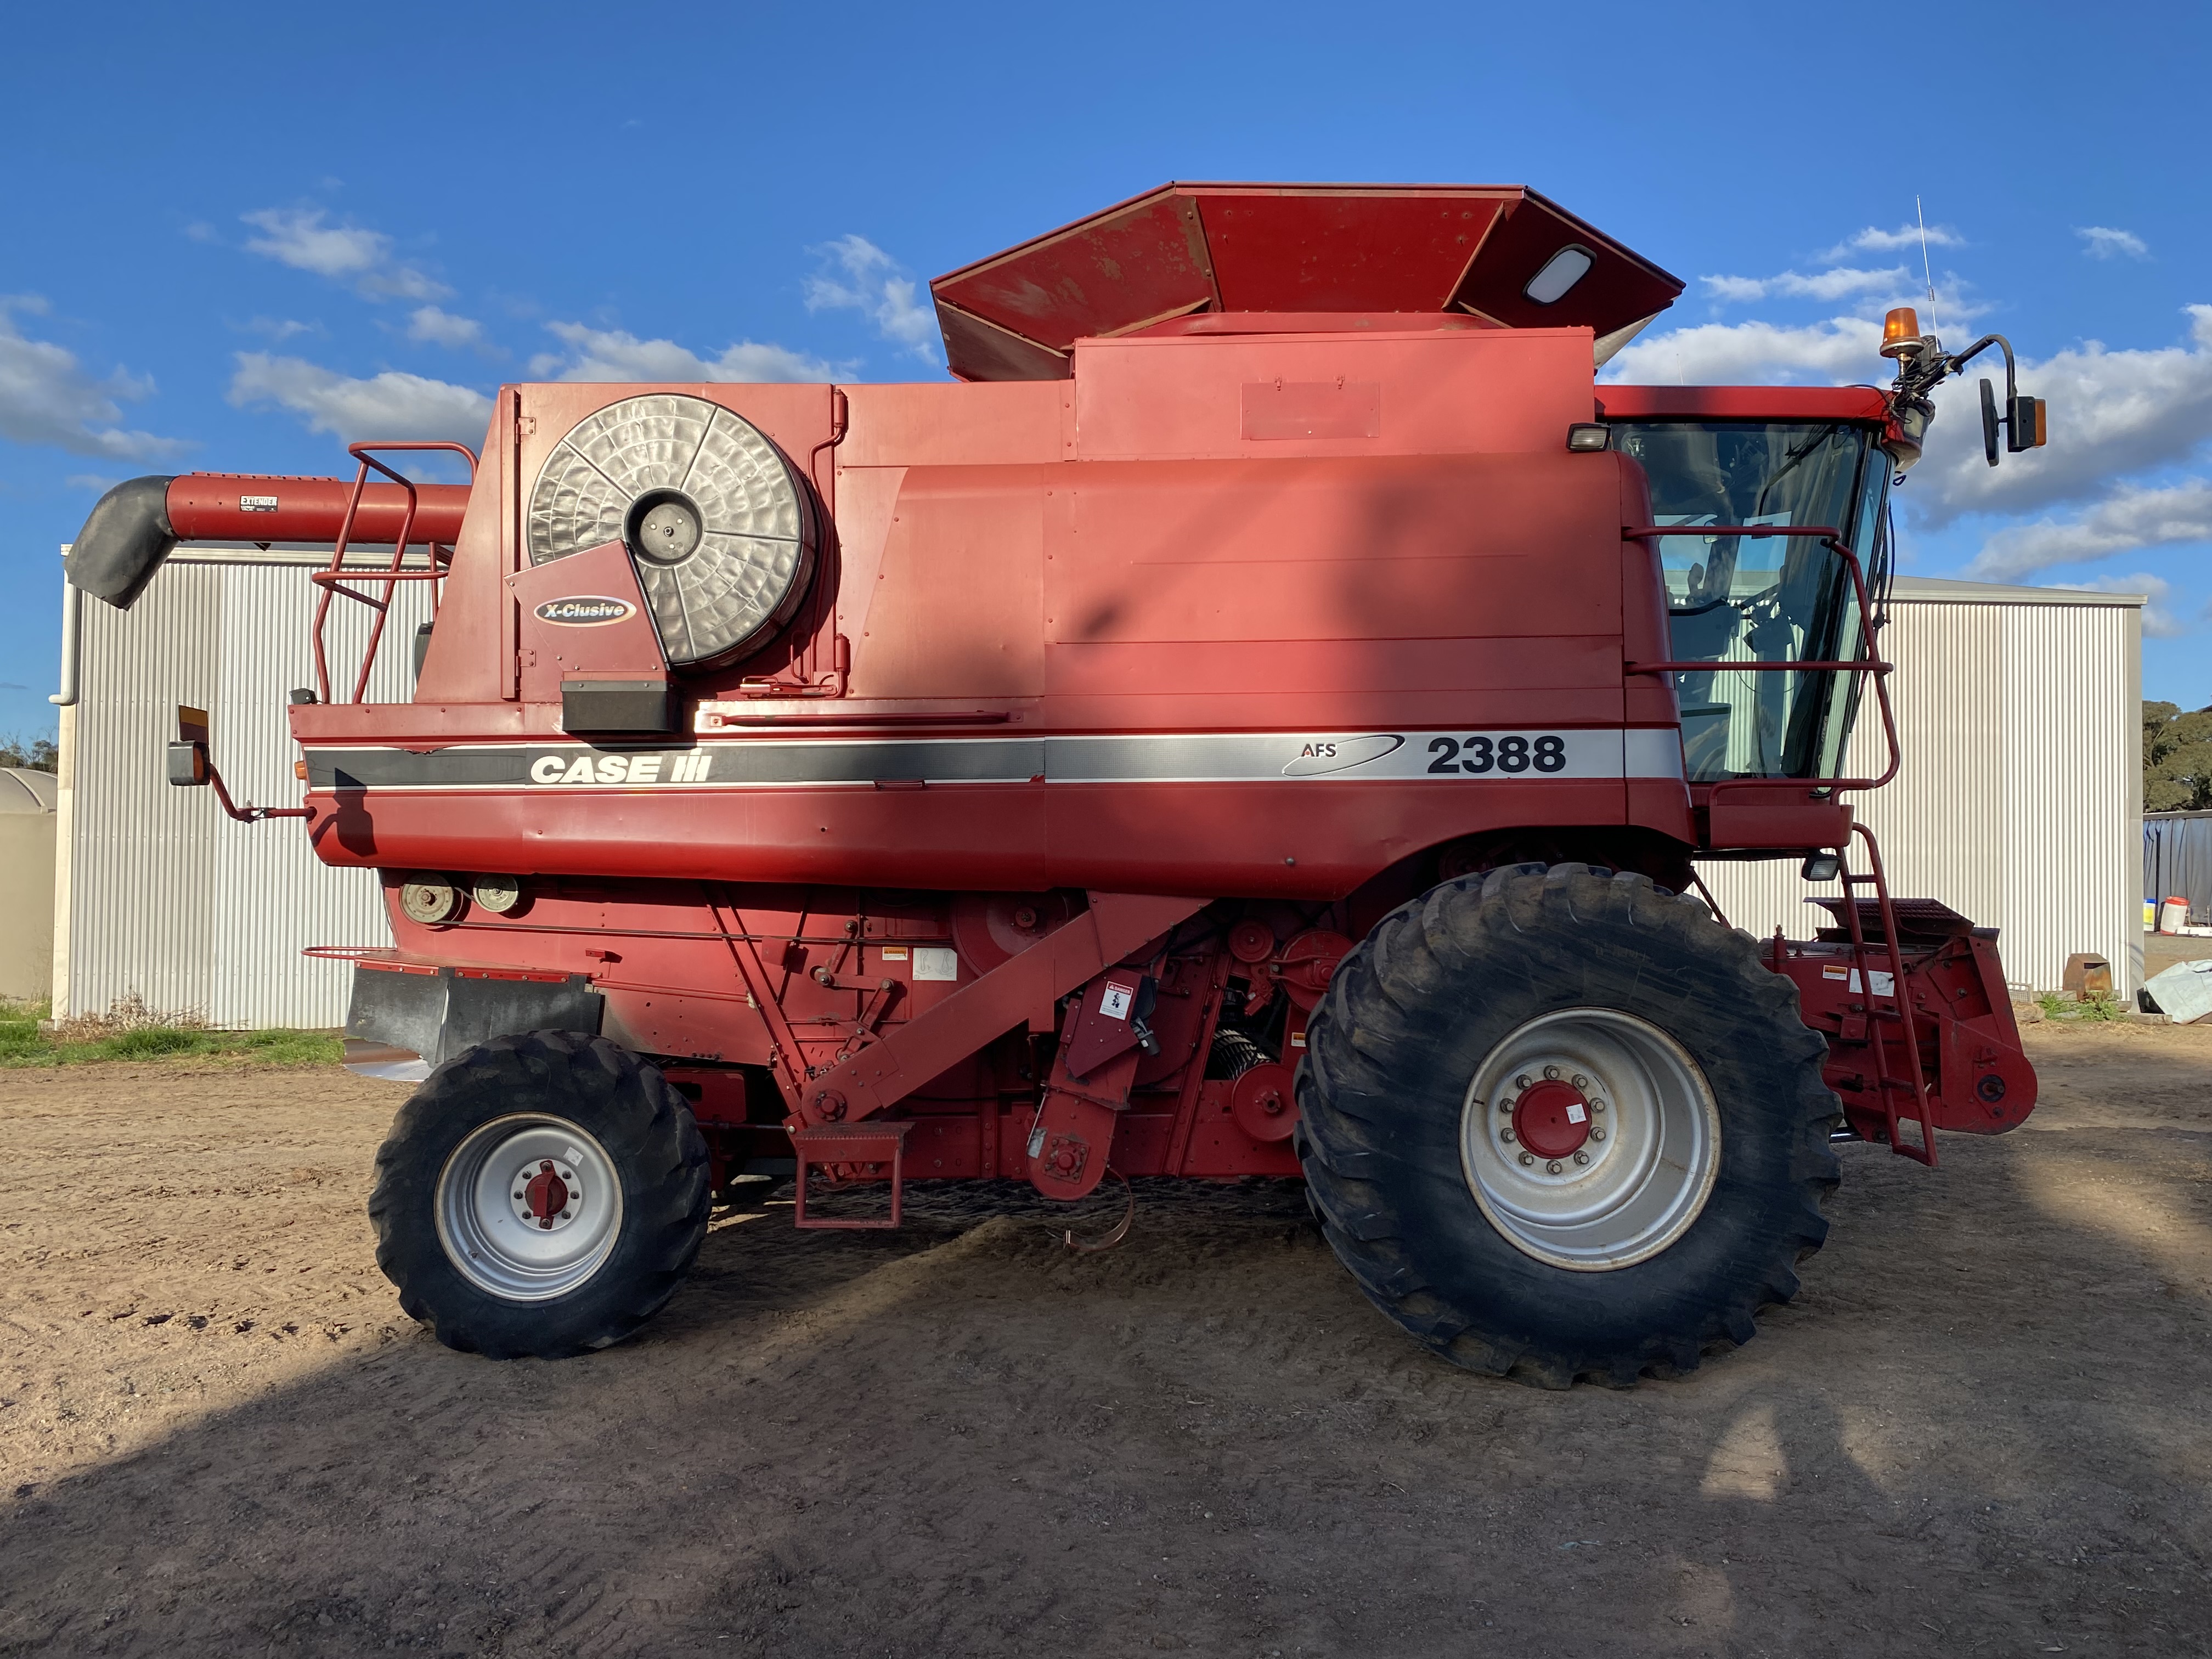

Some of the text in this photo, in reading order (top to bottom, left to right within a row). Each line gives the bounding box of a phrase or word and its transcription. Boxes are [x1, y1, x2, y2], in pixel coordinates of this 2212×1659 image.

[241, 496, 277, 506] EXTENDER
[544, 603, 624, 617] X-Clusive
[1301, 743, 1336, 757] AFS
[1427, 736, 1566, 773] 2388
[531, 755, 663, 783] CASE
